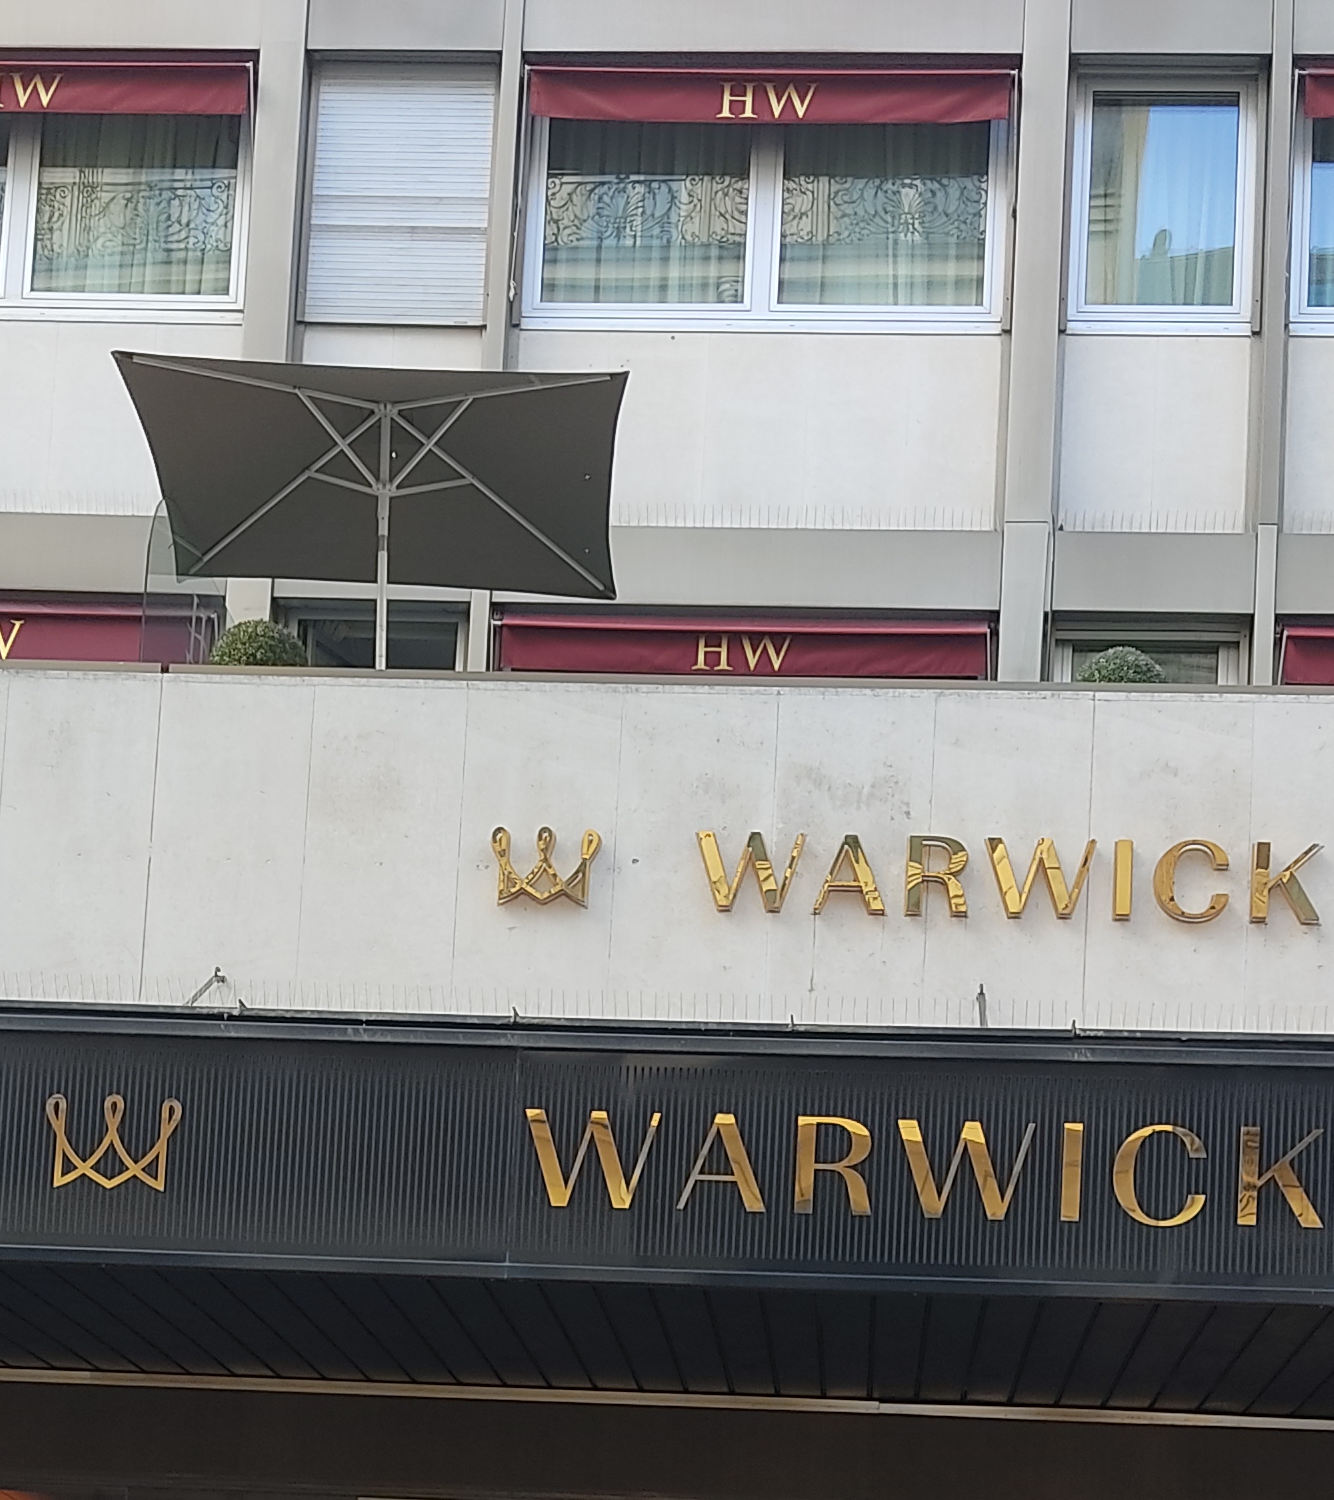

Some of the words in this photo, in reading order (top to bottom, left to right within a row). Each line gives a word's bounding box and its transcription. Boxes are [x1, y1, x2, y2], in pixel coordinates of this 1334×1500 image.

[715, 82, 817, 119] HW
[691, 635, 792, 672] HW
[695, 830, 1325, 927] WARWICK
[524, 1107, 1325, 1230] WARWICK
